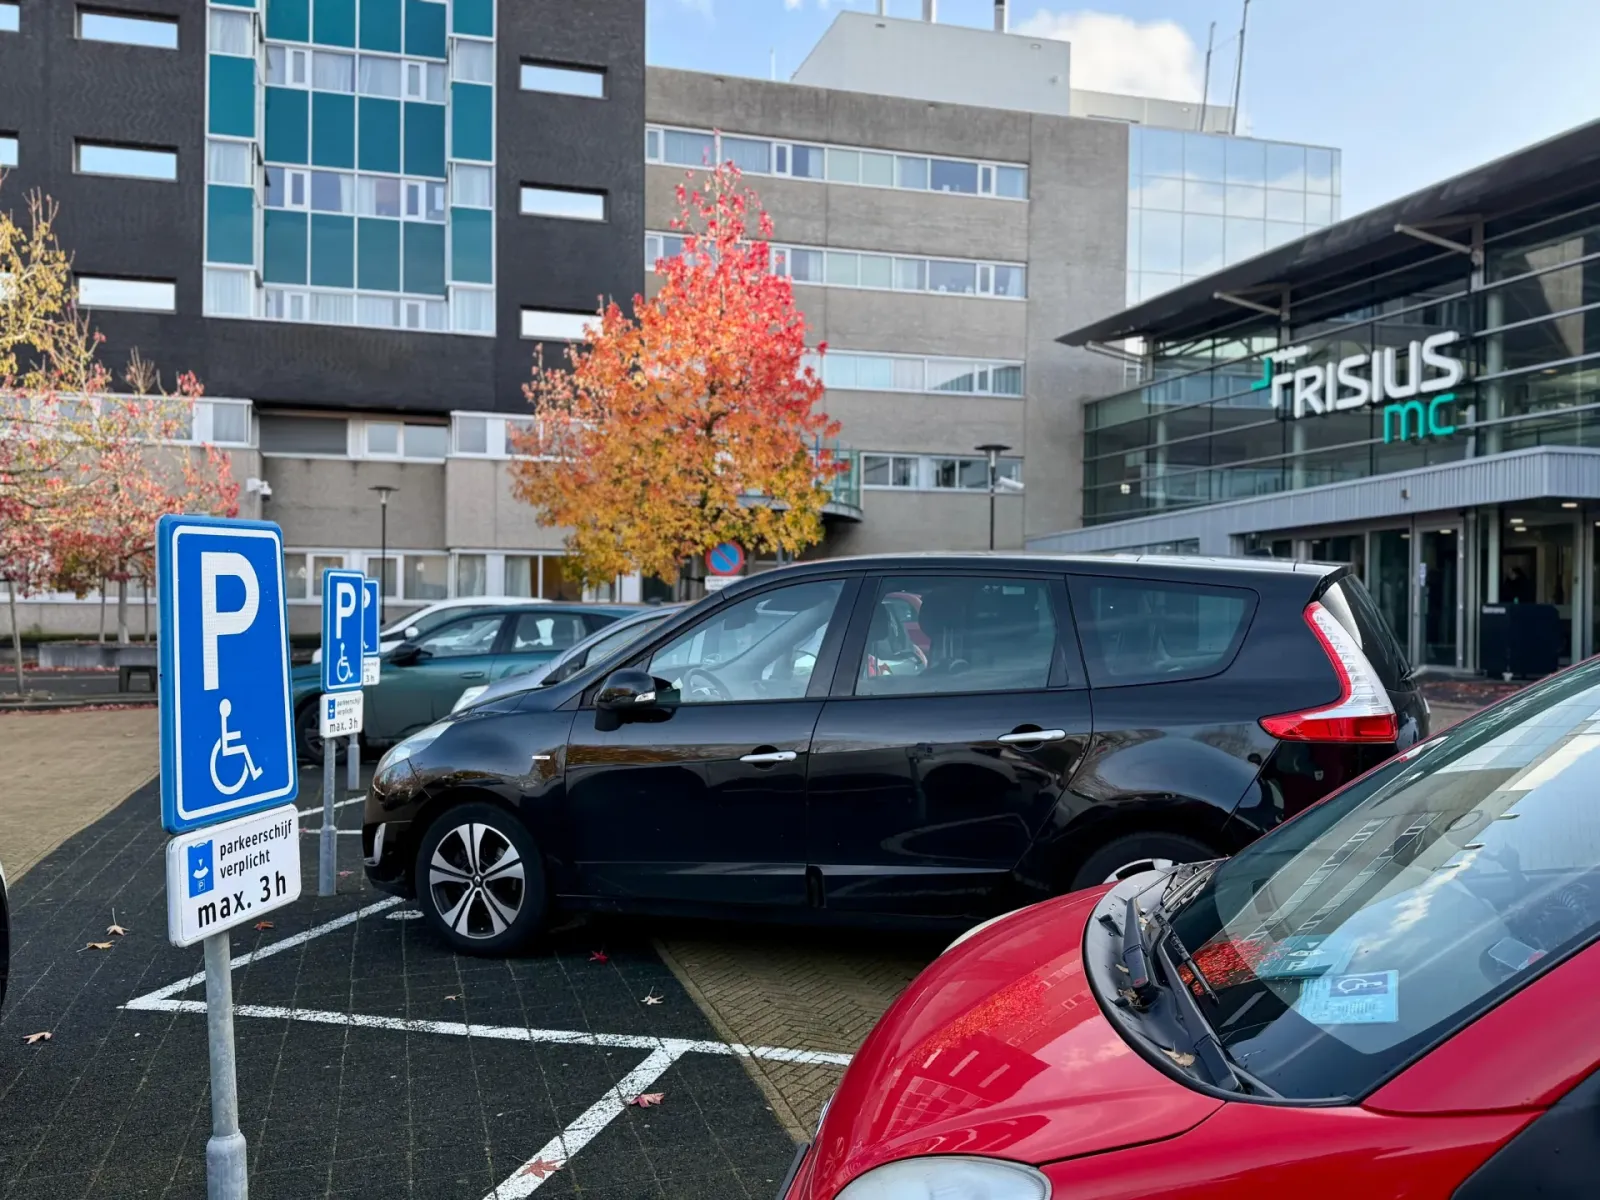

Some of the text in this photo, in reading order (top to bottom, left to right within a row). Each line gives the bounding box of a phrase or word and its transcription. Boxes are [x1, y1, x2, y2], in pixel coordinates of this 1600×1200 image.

[1264, 331, 1464, 419] FRISIUS
[200, 551, 260, 691] P
[336, 582, 356, 640] P
[330, 721, 347, 733] max.
[220, 819, 292, 861] parkeerschijf
[220, 849, 271, 879] verplicht
[197, 890, 252, 929] max.
